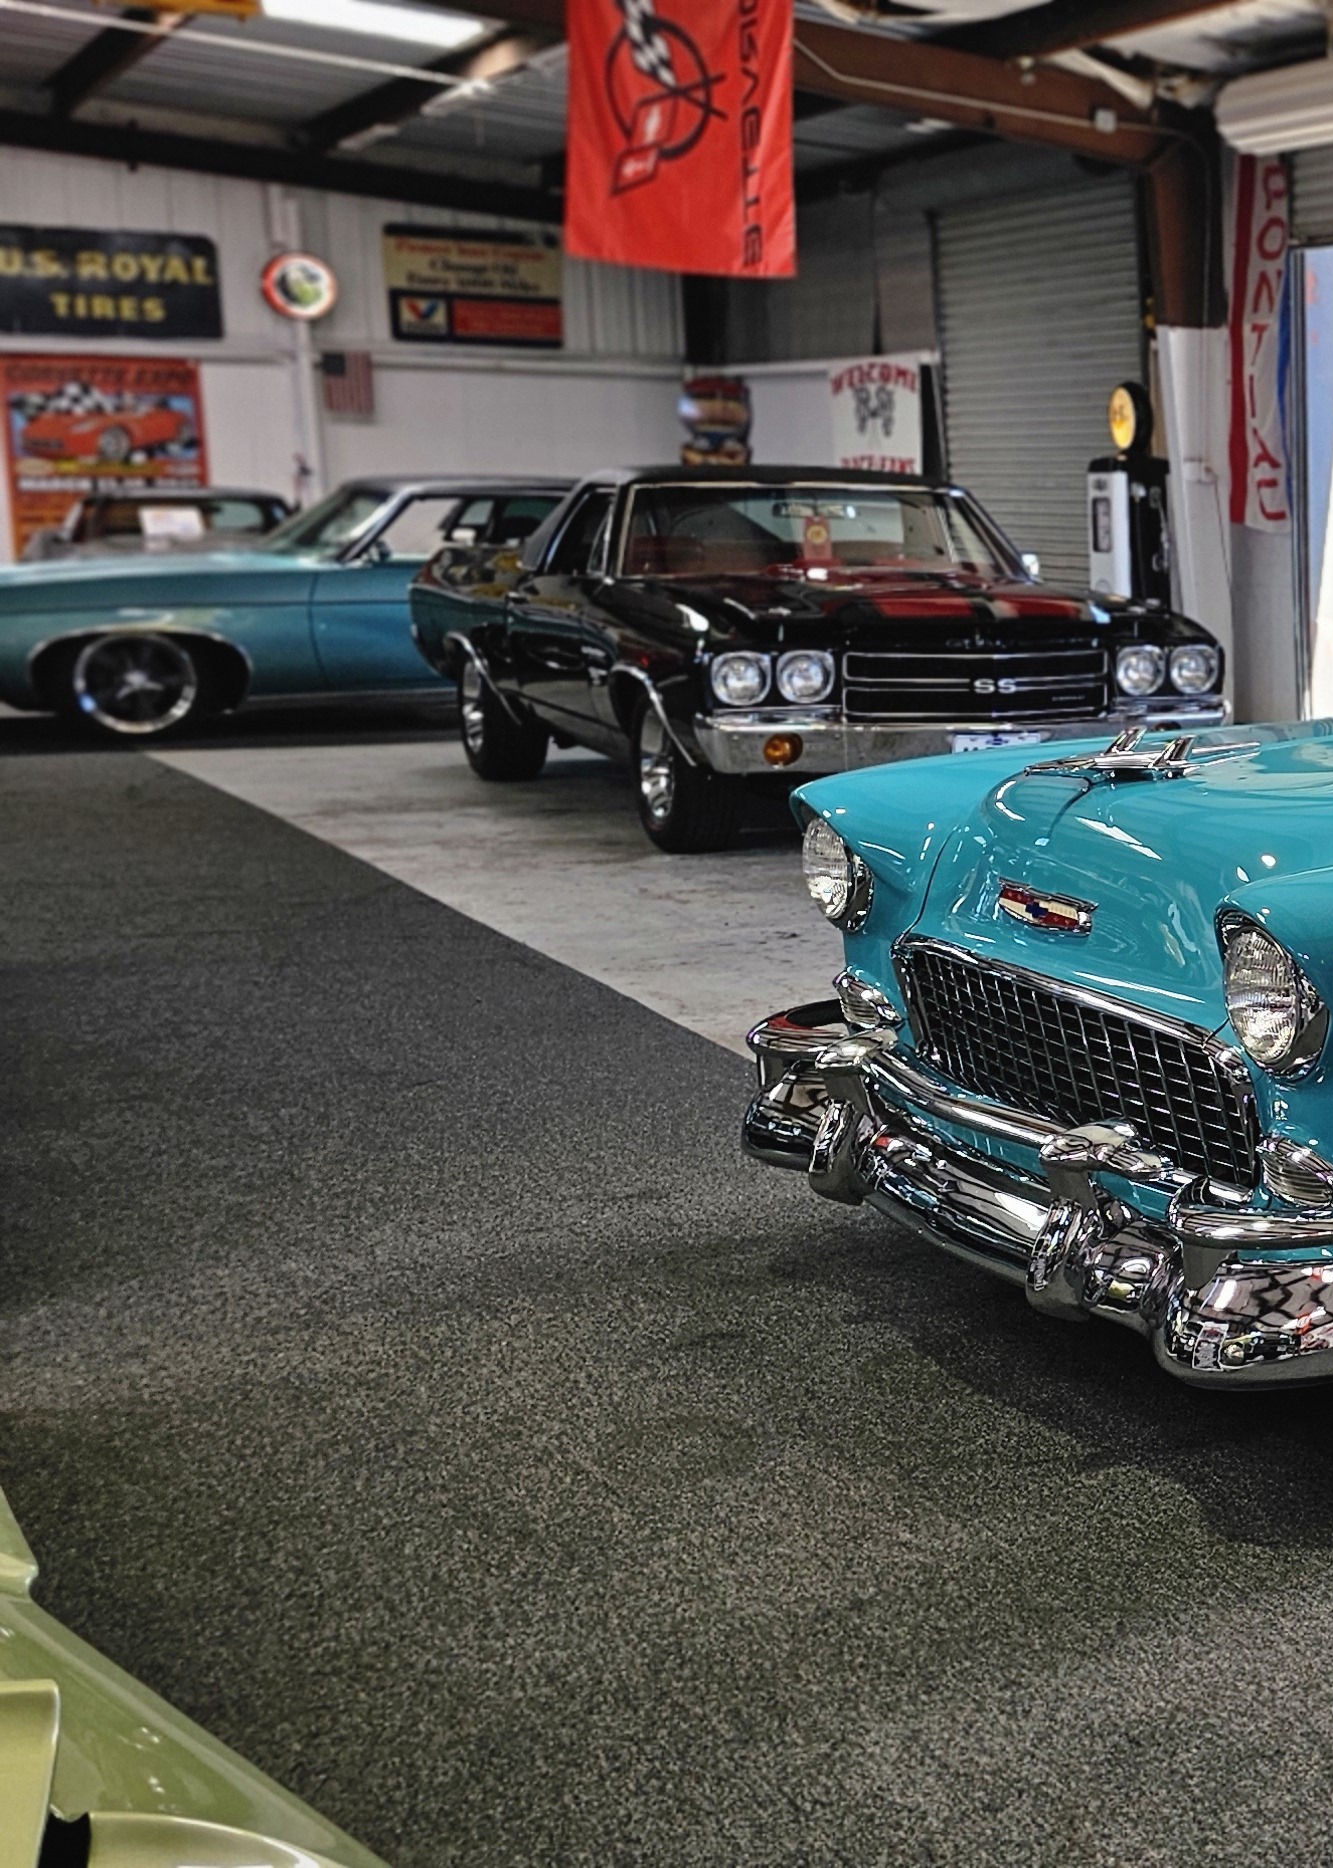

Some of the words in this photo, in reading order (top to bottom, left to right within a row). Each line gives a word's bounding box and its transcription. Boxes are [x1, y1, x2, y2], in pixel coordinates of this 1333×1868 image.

[75, 250, 213, 285] ROYAL
[50, 292, 167, 322] TIRES
[973, 678, 1017, 694] SS
